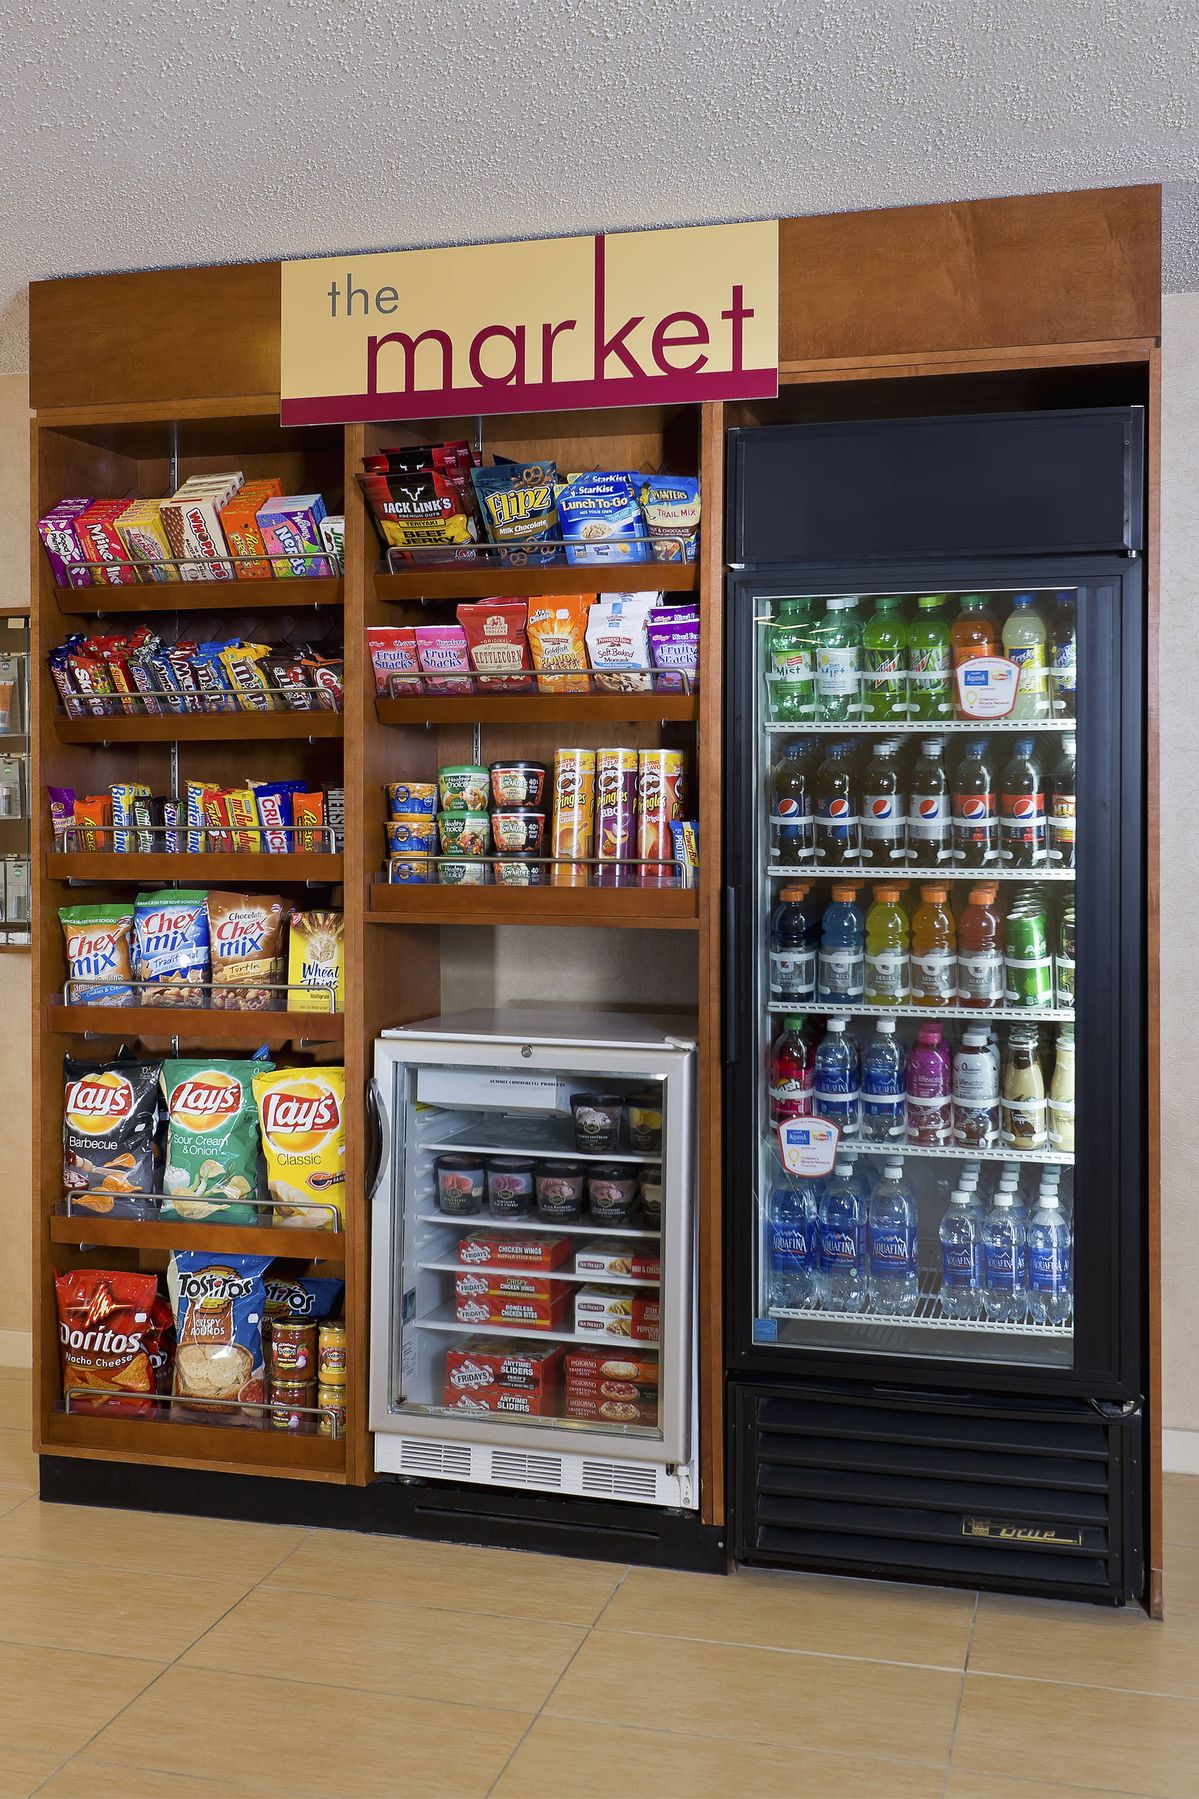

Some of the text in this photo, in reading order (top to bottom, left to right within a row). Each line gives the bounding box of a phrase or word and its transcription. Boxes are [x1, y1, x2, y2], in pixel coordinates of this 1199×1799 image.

[327, 272, 400, 318] the
[366, 235, 755, 395] market
[579, 485, 614, 495] StarKist
[651, 490, 688, 500] PLANTERS
[383, 498, 452, 514] JACK LINK'S
[561, 498, 598, 512] Lunch
[656, 508, 697, 518] TRAIL MIX
[514, 520, 547, 533] Chocolate
[403, 530, 446, 538] BEEF
[85, 522, 114, 563] Mike
[188, 508, 228, 578] WHOPPRS
[401, 536, 455, 546] JERKY
[376, 649, 410, 661] Fruity
[425, 649, 459, 660] Fruity
[544, 644, 568, 656] Goldfish
[598, 648, 635, 659] Soft Baked
[659, 644, 698, 656] Fruity
[423, 658, 463, 669] Snacks
[474, 650, 522, 664] KETTLECORN
[658, 654, 699, 664] Snacks
[374, 658, 414, 670] Snacks
[555, 793, 587, 815] Pringes
[142, 908, 200, 935] Chex
[216, 916, 268, 941] Chex
[66, 927, 124, 960] Chex
[145, 930, 190, 955] mix
[220, 932, 265, 958] mix
[72, 943, 117, 978] mix
[302, 960, 340, 979] Wheat
[66, 1082, 129, 1116] Lay's
[174, 1082, 239, 1116] Lay's
[266, 1094, 334, 1134] Lay's
[69, 1136, 118, 1151] Barbecue
[173, 1134, 229, 1147] Sour Cream
[189, 1145, 218, 1156] Onion
[276, 1153, 322, 1166] Classic
[498, 1246, 523, 1254] CHICKEN
[773, 1236, 807, 1253] AQUAFINA
[822, 1240, 857, 1257] AQUAFINA
[873, 1242, 909, 1259] AQUAFINA
[523, 1311, 538, 1319] BITES
[195, 1318, 222, 1329] CRISPY
[60, 1321, 142, 1354] Doritos
[65, 1352, 93, 1366] Nacho
[96, 1354, 133, 1368] Cheese
[503, 1360, 532, 1369] ANYTIME!
[500, 1366, 534, 1376] SLIDERS
[500, 1395, 528, 1405] ANYTIME!
[496, 1402, 530, 1412] SLIDERS
